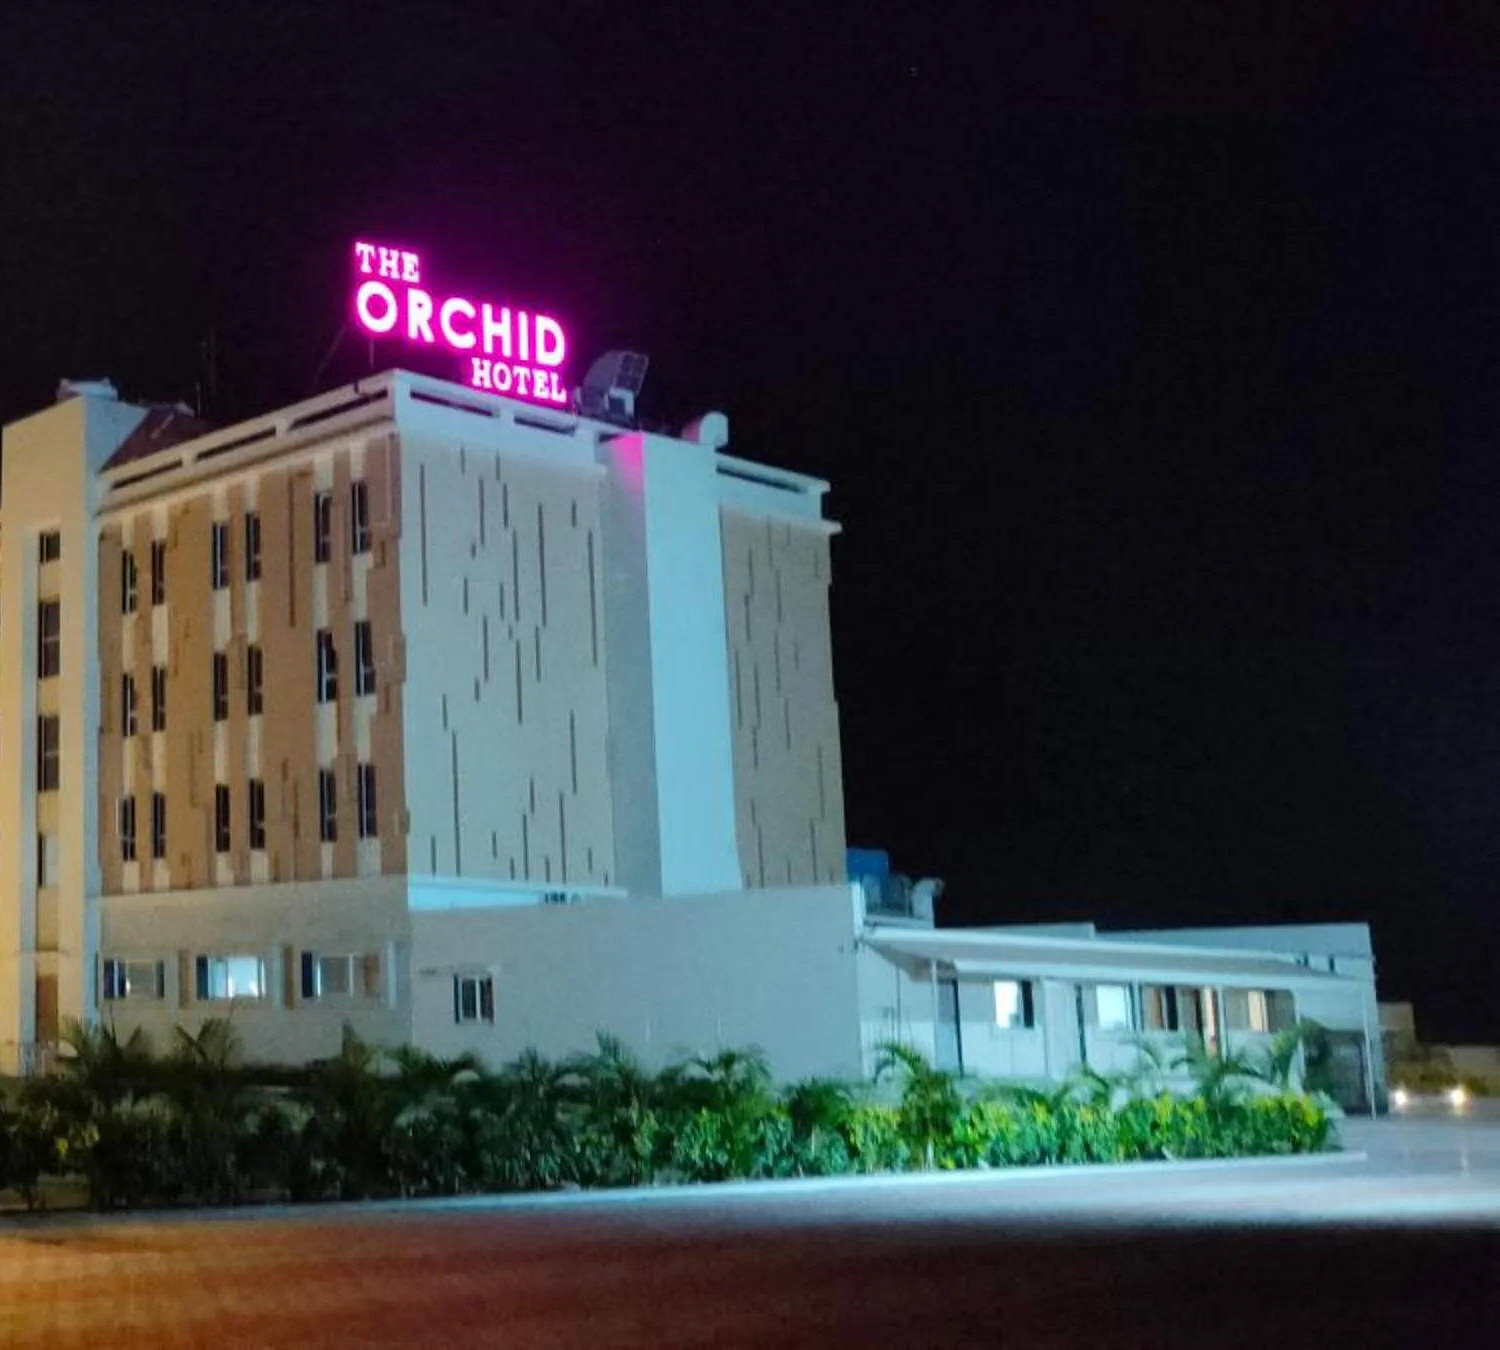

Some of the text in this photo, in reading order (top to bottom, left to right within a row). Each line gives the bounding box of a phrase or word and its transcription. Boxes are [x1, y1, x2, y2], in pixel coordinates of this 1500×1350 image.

[356, 242, 419, 282] THE
[356, 281, 566, 367] ORCHID
[471, 357, 567, 402] HOTEL
